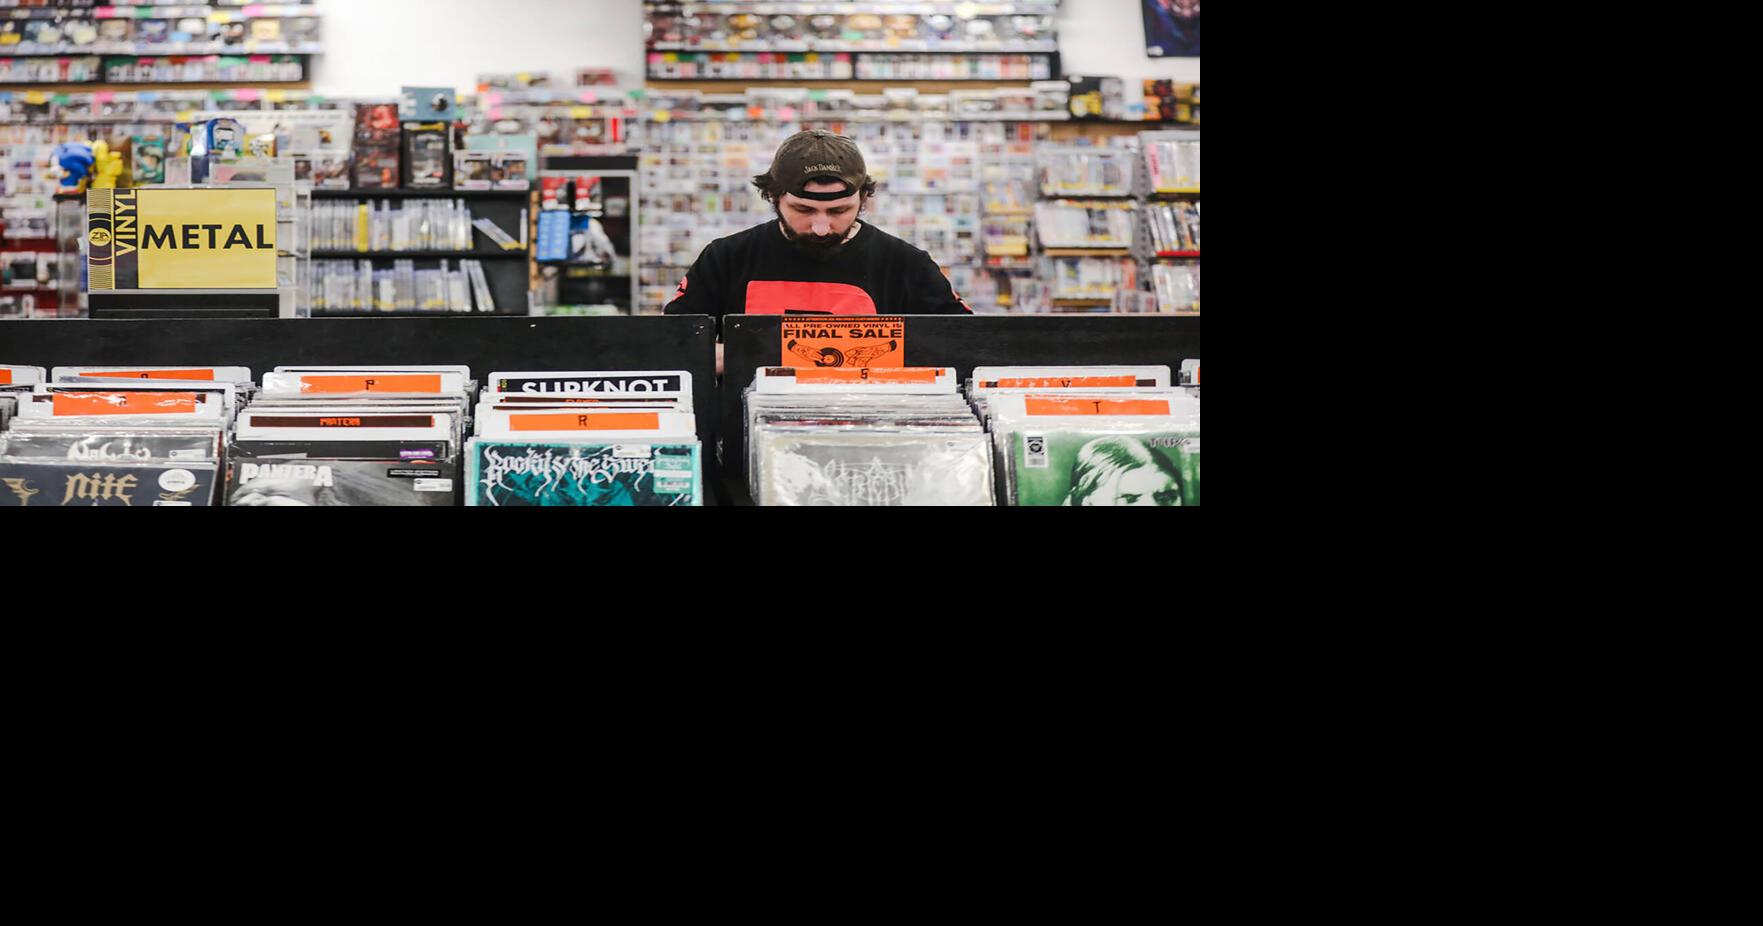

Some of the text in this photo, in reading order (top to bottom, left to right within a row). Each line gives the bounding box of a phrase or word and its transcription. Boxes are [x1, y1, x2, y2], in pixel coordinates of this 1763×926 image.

[115, 189, 137, 257] VINYL
[141, 224, 274, 249] METAL
[783, 329, 902, 339] FINAL SALE
[365, 379, 375, 390] P
[1092, 401, 1102, 414] T
[578, 415, 588, 427] R
[239, 463, 333, 487] PANTERA
